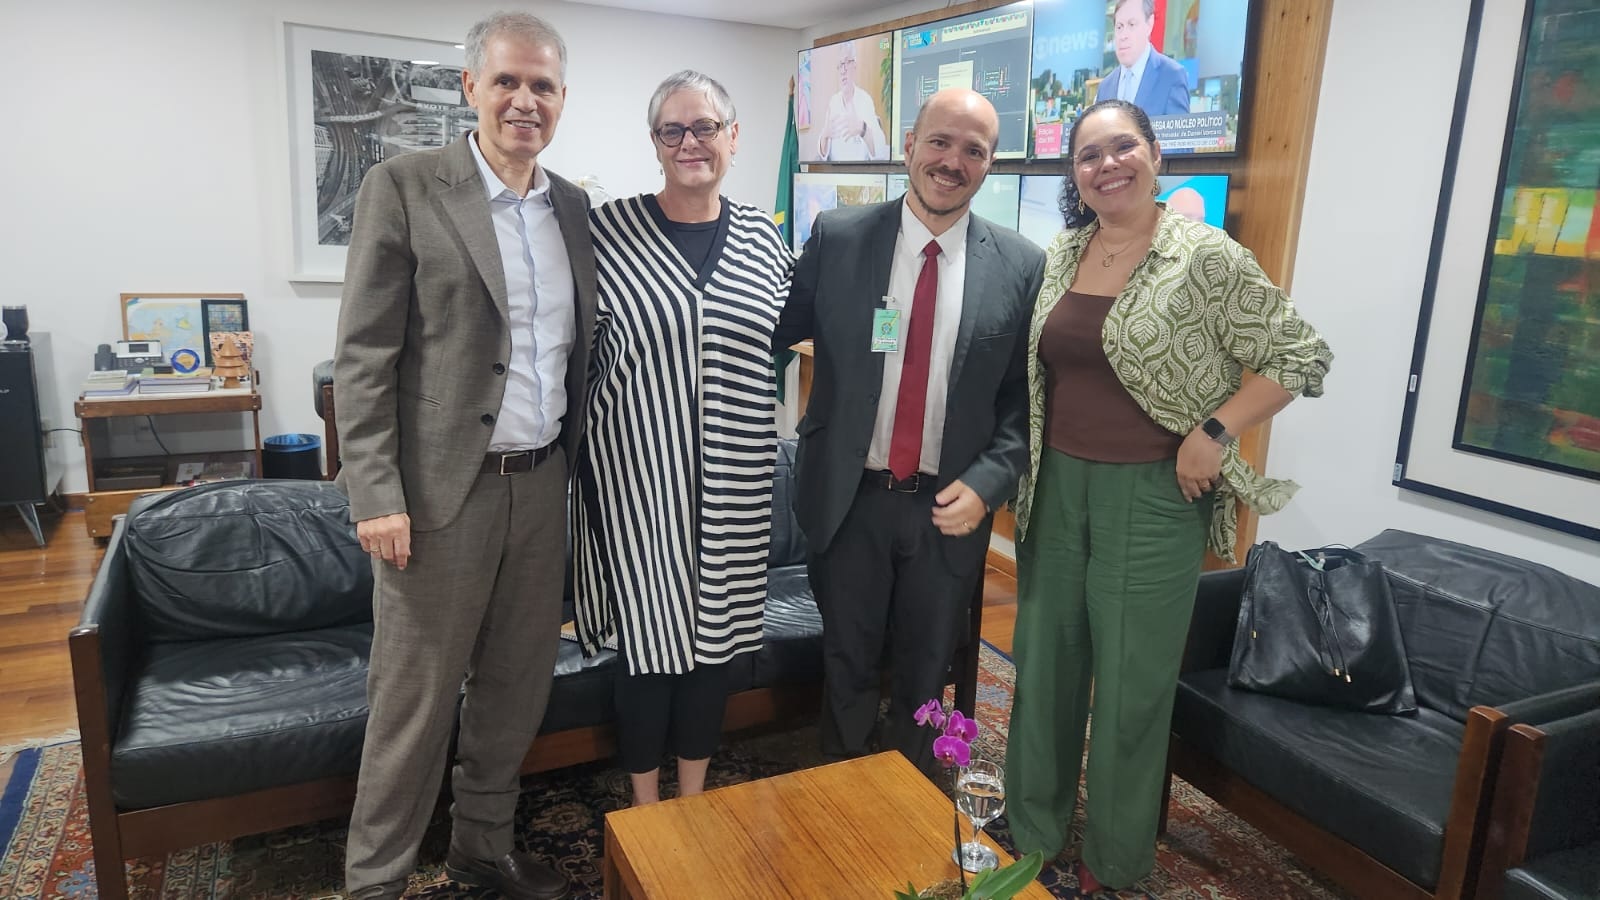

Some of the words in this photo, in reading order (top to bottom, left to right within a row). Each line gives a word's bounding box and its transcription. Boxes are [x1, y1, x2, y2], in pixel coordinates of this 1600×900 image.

[1048, 29, 1099, 56] news
[330, 110, 383, 123] DEMOCRACIA
[1197, 115, 1223, 128] POLÍTICO
